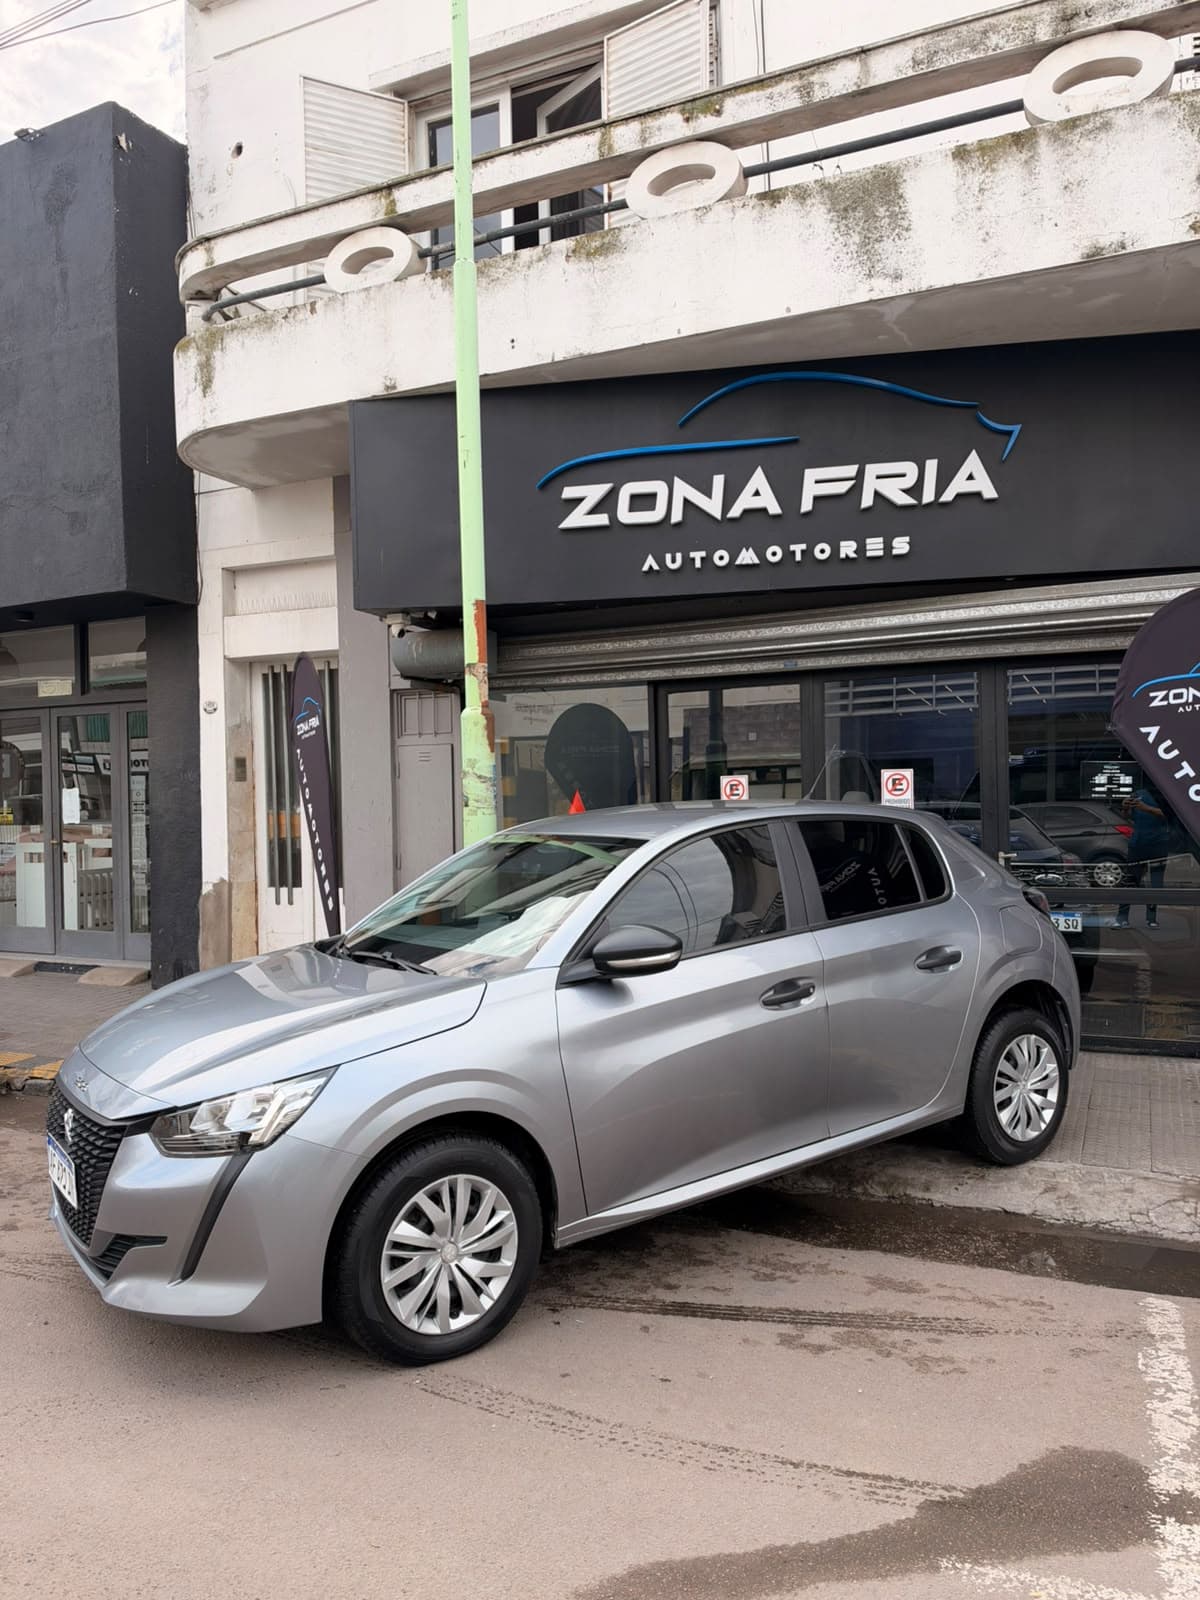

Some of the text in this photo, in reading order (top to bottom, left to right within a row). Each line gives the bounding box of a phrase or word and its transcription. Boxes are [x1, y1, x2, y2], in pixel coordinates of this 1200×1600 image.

[558, 449, 999, 529] ZONA FRIA
[641, 536, 911, 573] AUTOMOTORES
